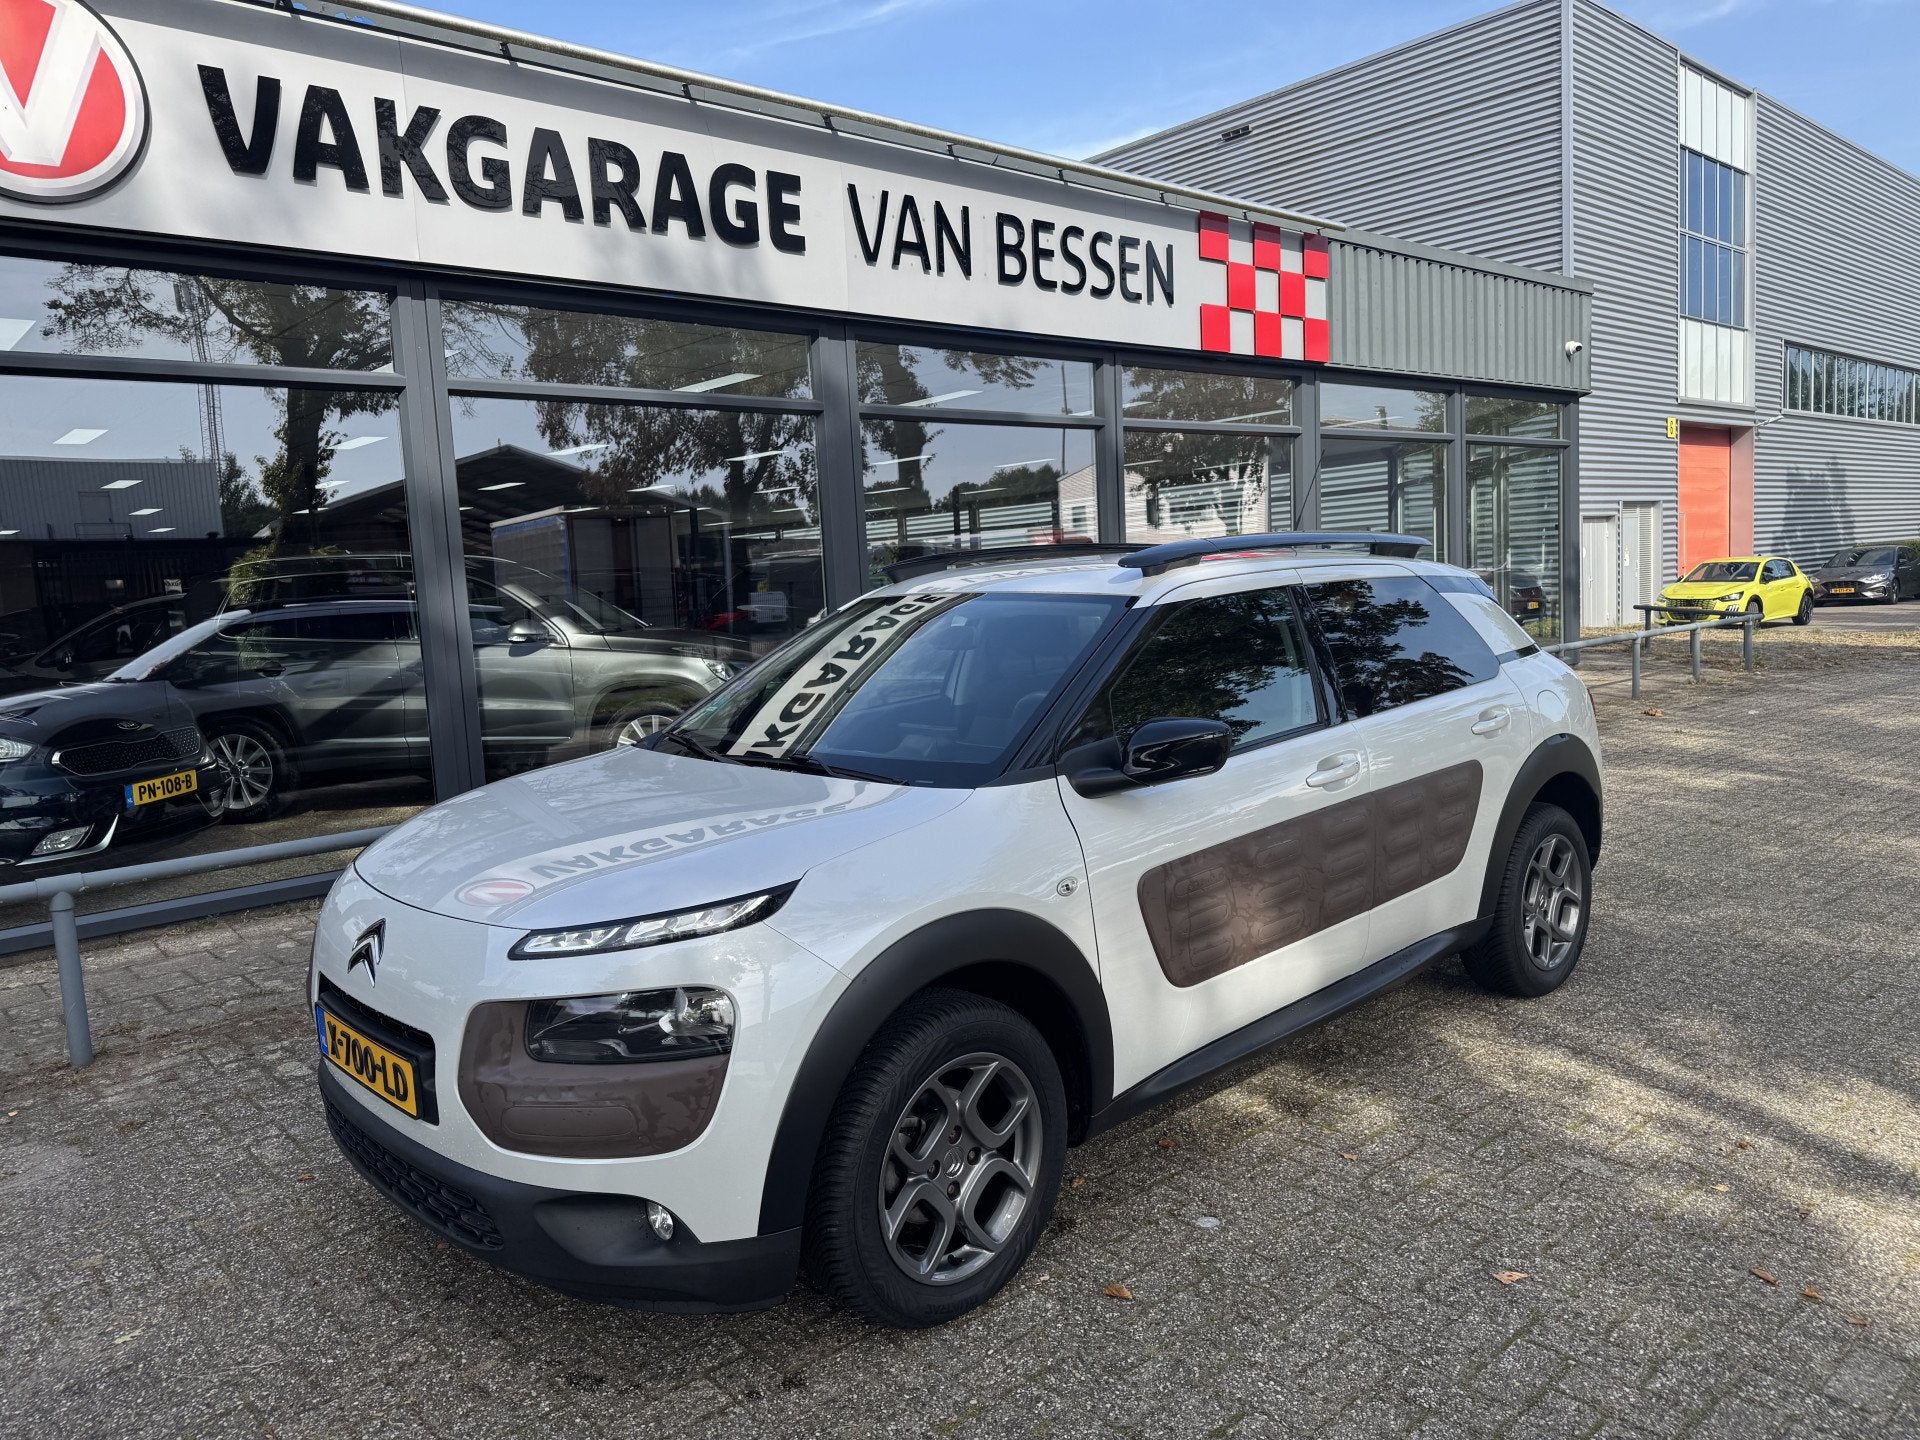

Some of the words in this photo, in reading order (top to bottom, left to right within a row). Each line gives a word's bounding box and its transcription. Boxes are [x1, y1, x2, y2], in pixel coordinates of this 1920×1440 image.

[197, 64, 805, 253] VAKGARAGE
[847, 183, 971, 277] VAN
[996, 212, 1174, 307] BESSEN
[138, 774, 192, 801] PN-108-B
[327, 1020, 408, 1101] X-700-LD
